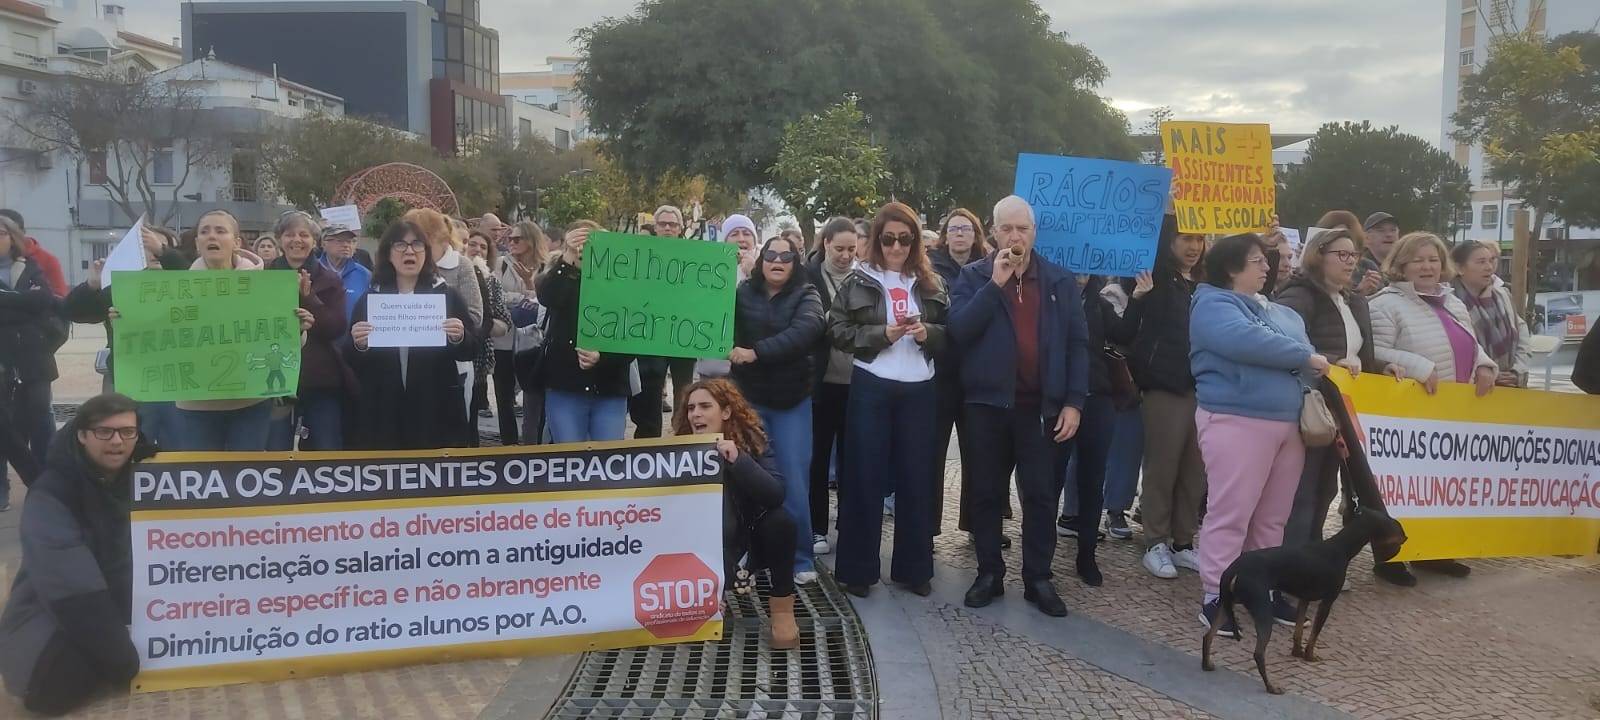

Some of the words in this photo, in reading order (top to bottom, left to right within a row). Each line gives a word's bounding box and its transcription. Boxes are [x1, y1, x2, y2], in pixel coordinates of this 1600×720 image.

[1171, 125, 1226, 155] MAIS
[1171, 156, 1264, 184] ASSISTENTES
[1029, 167, 1163, 215] RÁCIOS
[1038, 210, 1158, 239] DAPTADOS
[1176, 205, 1207, 230] NAS
[1213, 206, 1274, 229] ESCOLAS
[586, 245, 730, 290] Melhores
[1034, 242, 1150, 273] EALIDADE
[139, 276, 251, 303] FARTOS
[380, 302, 402, 310] Quem
[403, 302, 421, 310] cuida
[423, 302, 436, 310] dos
[169, 305, 200, 324] DE
[398, 313, 417, 321] filhos
[579, 301, 728, 353] Salários!
[120, 317, 292, 356] TRABALHAR
[140, 361, 200, 392] POR
[207, 350, 247, 392] 2
[1369, 426, 1426, 459] ESCOLAS
[1429, 431, 1469, 461] COM
[1470, 429, 1551, 471] CONDIÇÕES
[134, 469, 229, 501] PARA
[235, 467, 284, 498] OS
[289, 459, 497, 495] ASSISTENTES
[503, 450, 721, 484] OPERACIONAIS
[1375, 473, 1406, 506] ARA
[1407, 475, 1467, 507] ALUNOS
[1468, 476, 1480, 507] E
[1481, 477, 1495, 507] P.
[1497, 477, 1517, 507] DE
[146, 521, 364, 551] Reconhecimento
[369, 516, 400, 539] da
[405, 509, 538, 536] diversidade
[543, 507, 571, 529] de
[576, 503, 662, 531] funções
[148, 554, 330, 587] Diferenciação
[334, 547, 421, 575] salarial
[427, 548, 480, 568] com
[486, 548, 500, 565] a
[505, 535, 643, 565] antiguidade
[146, 592, 251, 622] Carreira
[257, 584, 388, 618] específica
[393, 586, 409, 604] e
[415, 579, 461, 603] não
[466, 571, 602, 599] abrangente
[147, 625, 300, 660] Diminuição
[305, 623, 339, 646] do
[345, 617, 403, 643] ratio
[408, 614, 489, 637] alunos
[495, 611, 535, 636] por
[540, 604, 588, 628] A.O.
